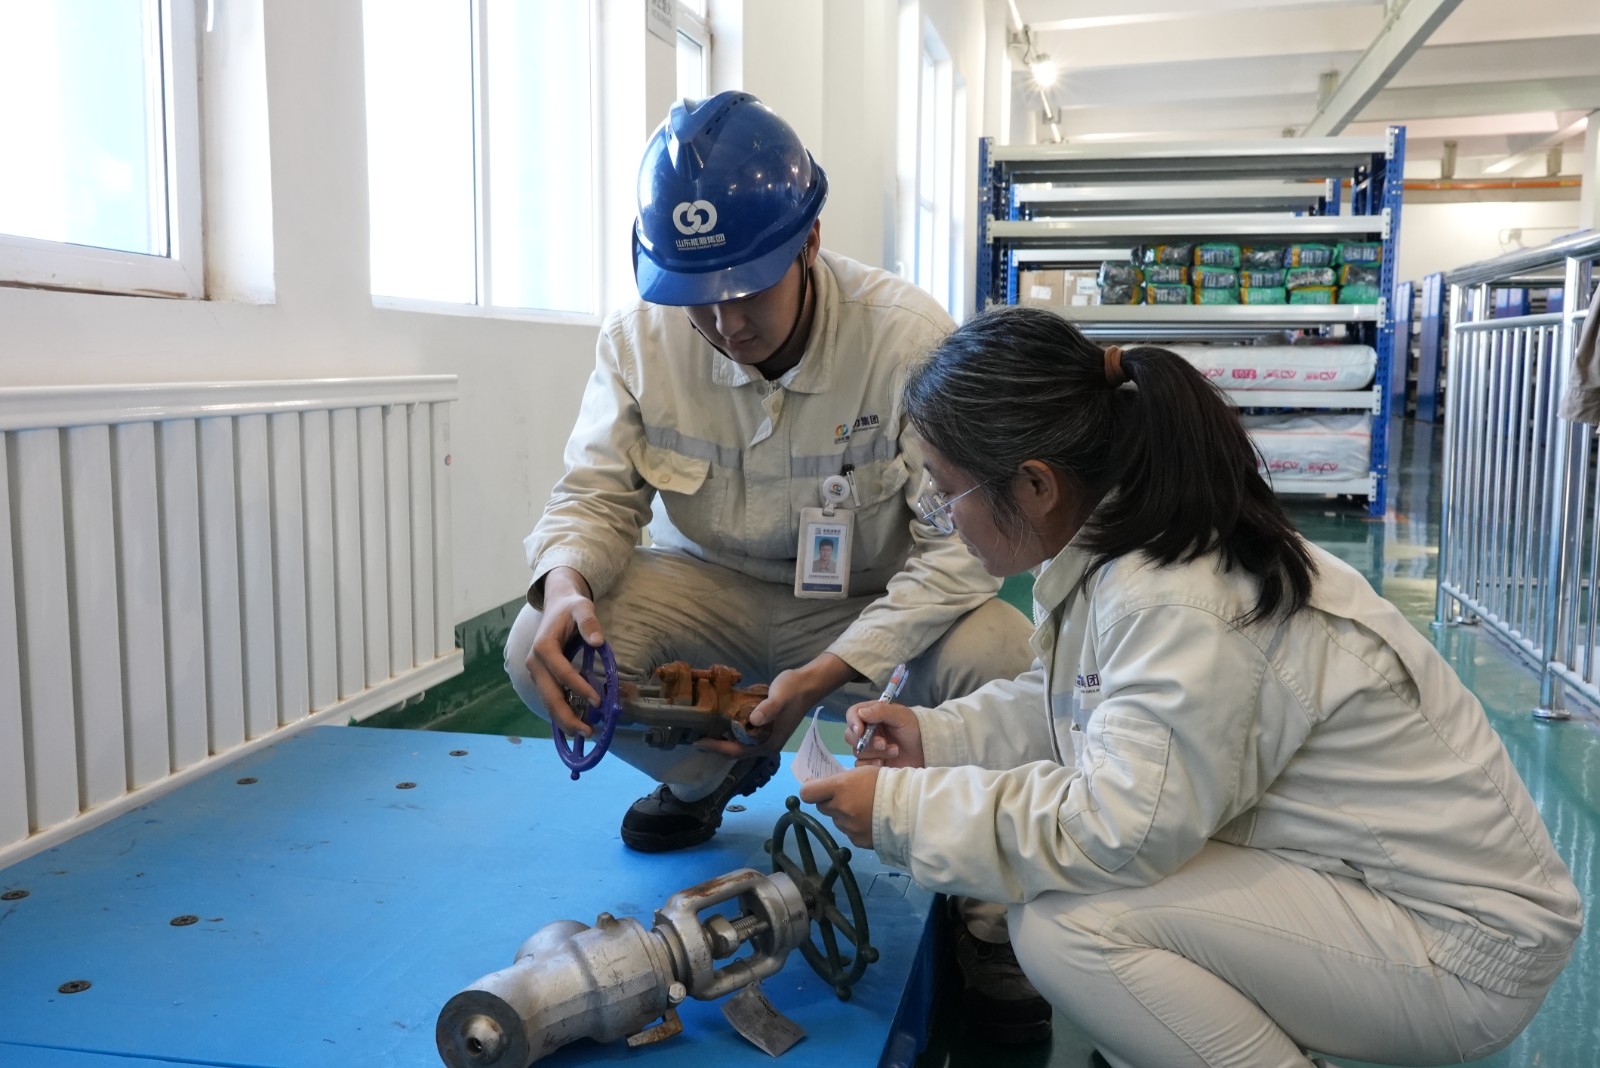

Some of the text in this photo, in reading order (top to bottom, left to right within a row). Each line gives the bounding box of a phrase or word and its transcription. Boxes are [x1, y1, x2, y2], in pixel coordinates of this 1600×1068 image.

[675, 233, 726, 248] 山东能源集团
